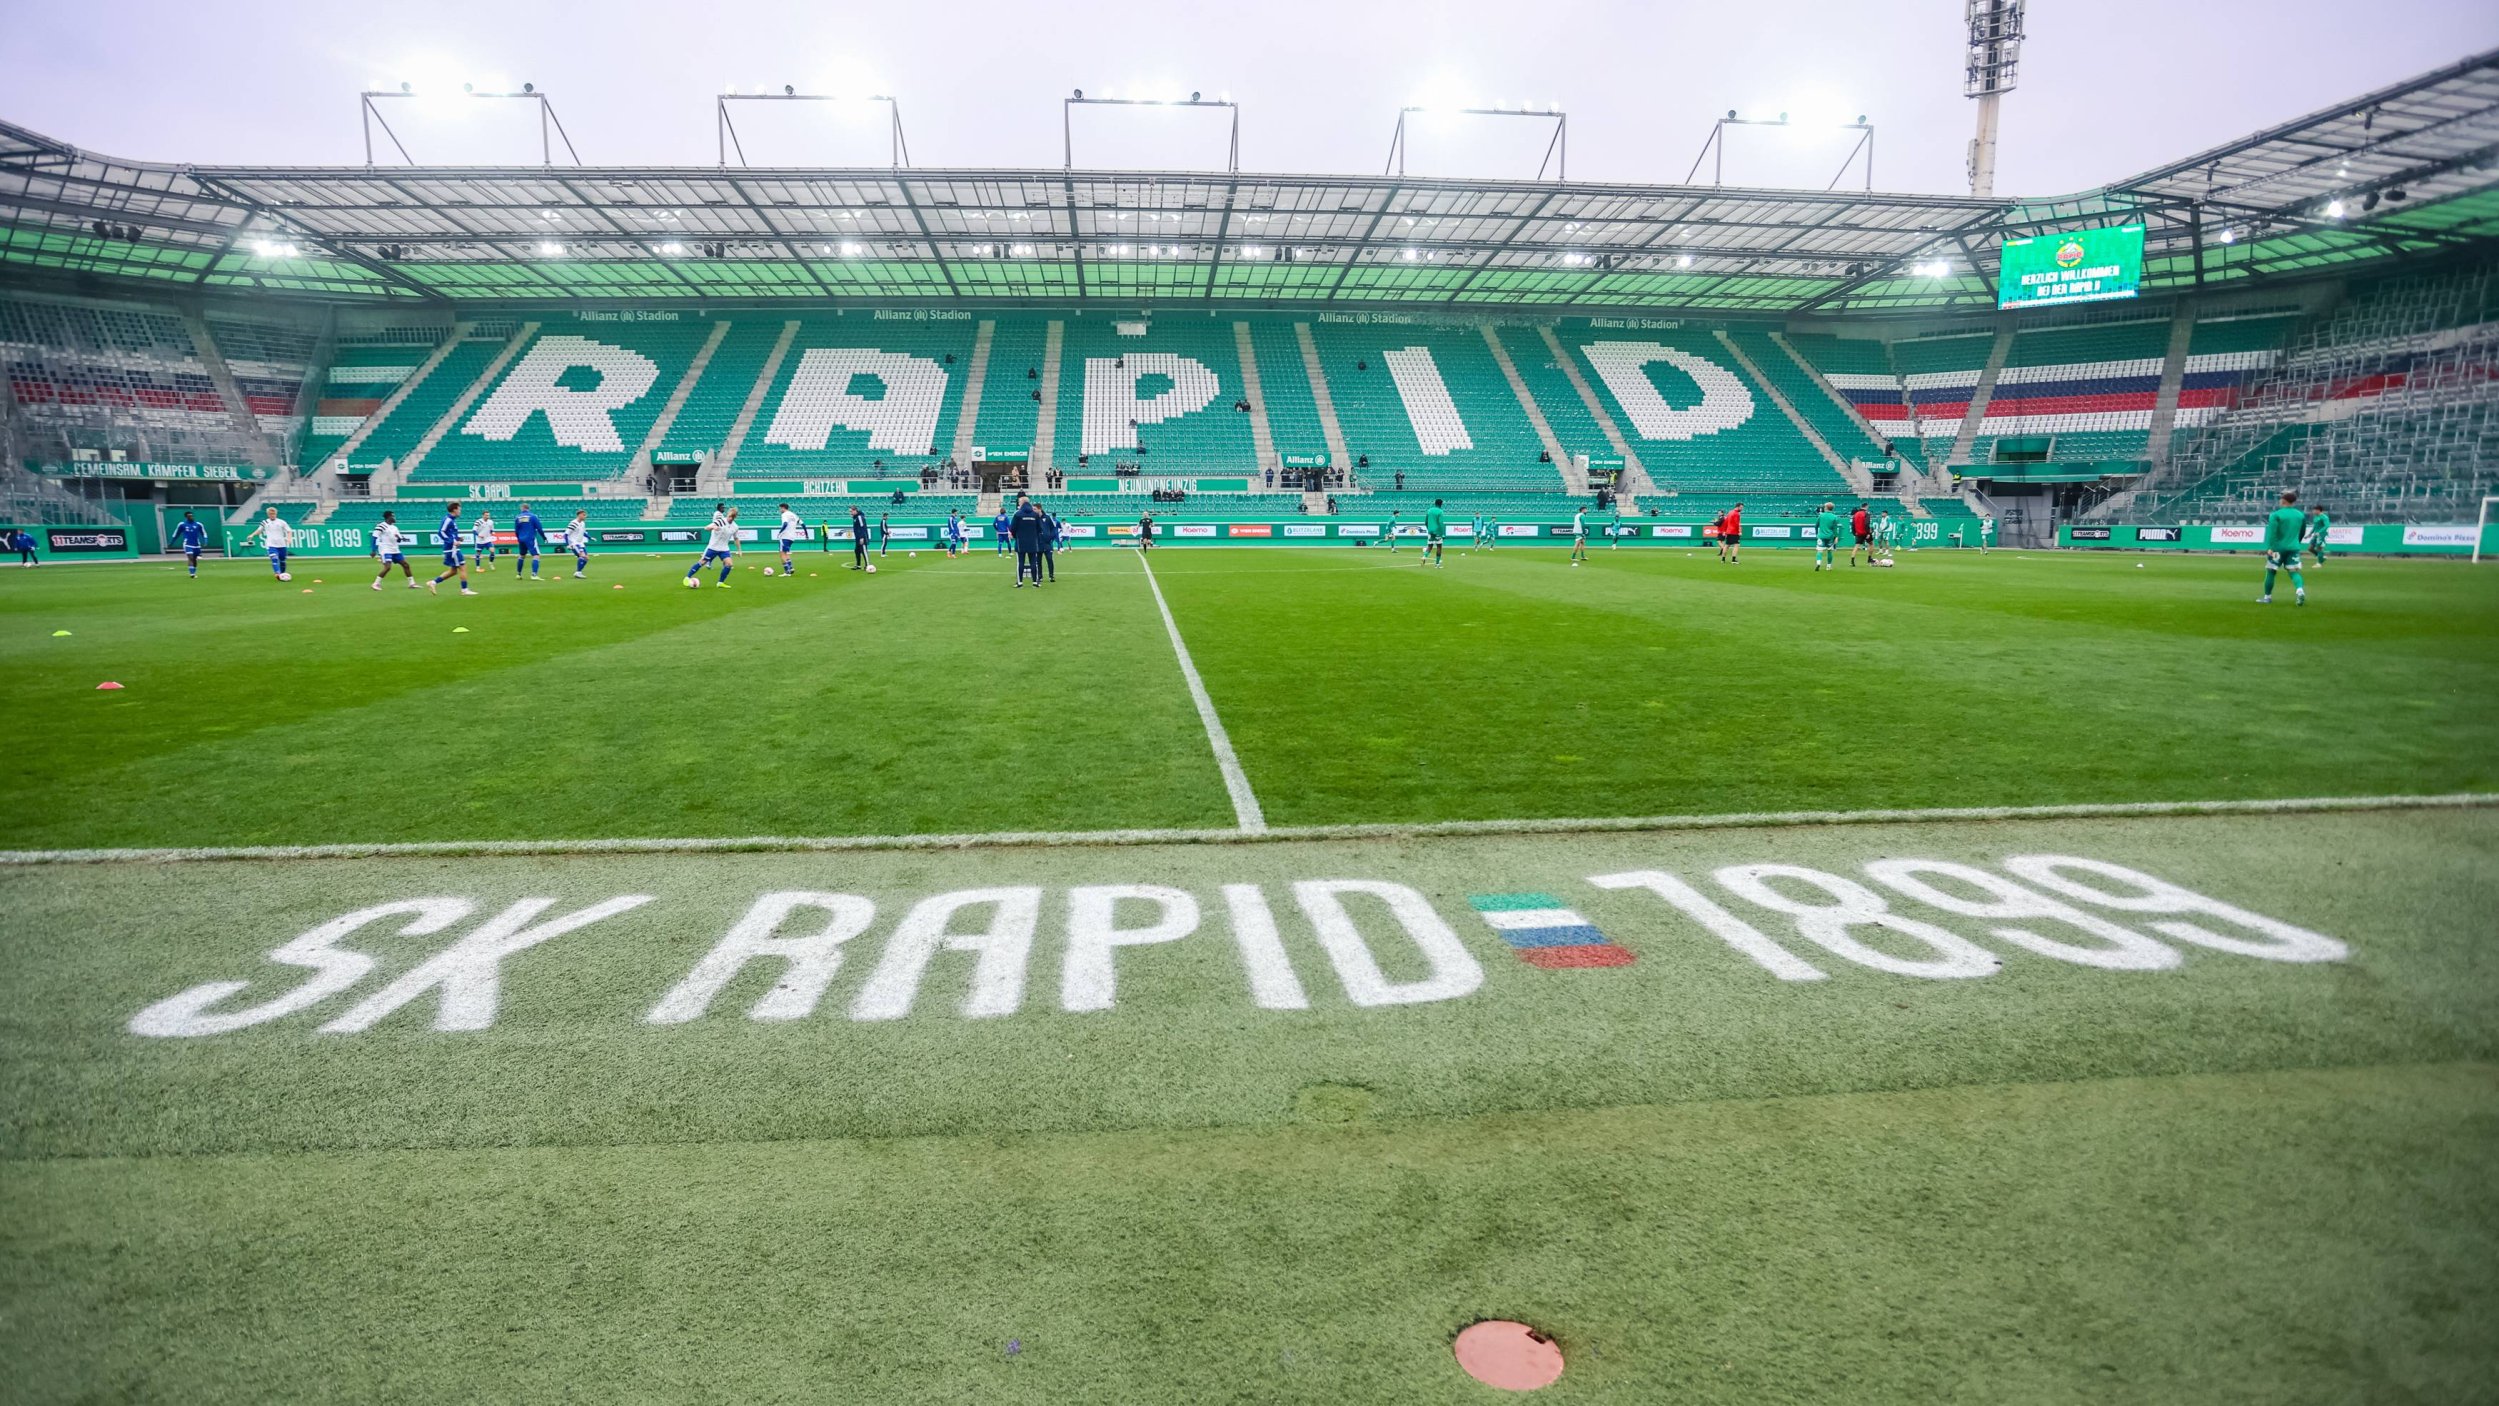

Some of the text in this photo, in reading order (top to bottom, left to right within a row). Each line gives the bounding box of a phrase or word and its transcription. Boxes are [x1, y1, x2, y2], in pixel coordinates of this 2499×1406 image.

[2021, 265, 2120, 285] HERZLICH WILLKOMMEN
[580, 311, 679, 321] Allianz Stadion
[874, 310, 971, 320] Allianz Stadion
[1318, 313, 1411, 324] Allianz Stadion
[1590, 318, 1678, 329] Allianz Stadion
[461, 335, 1755, 455] RAPID
[657, 452, 691, 461] Allianz
[1286, 456, 1314, 464] Allianz
[469, 484, 511, 498] SK RAPID
[803, 480, 848, 495] ACHTZEHN
[1118, 479, 1198, 493] NEUNUNDNEUNZIG
[661, 532, 688, 540] PUMA
[1914, 522, 1938, 540] 899
[2139, 529, 2167, 540] PUMA
[326, 529, 362, 548] 1899
[2417, 533, 2476, 542] Domino's Pizza
[128, 854, 2350, 1038] SK RAPID 1899
